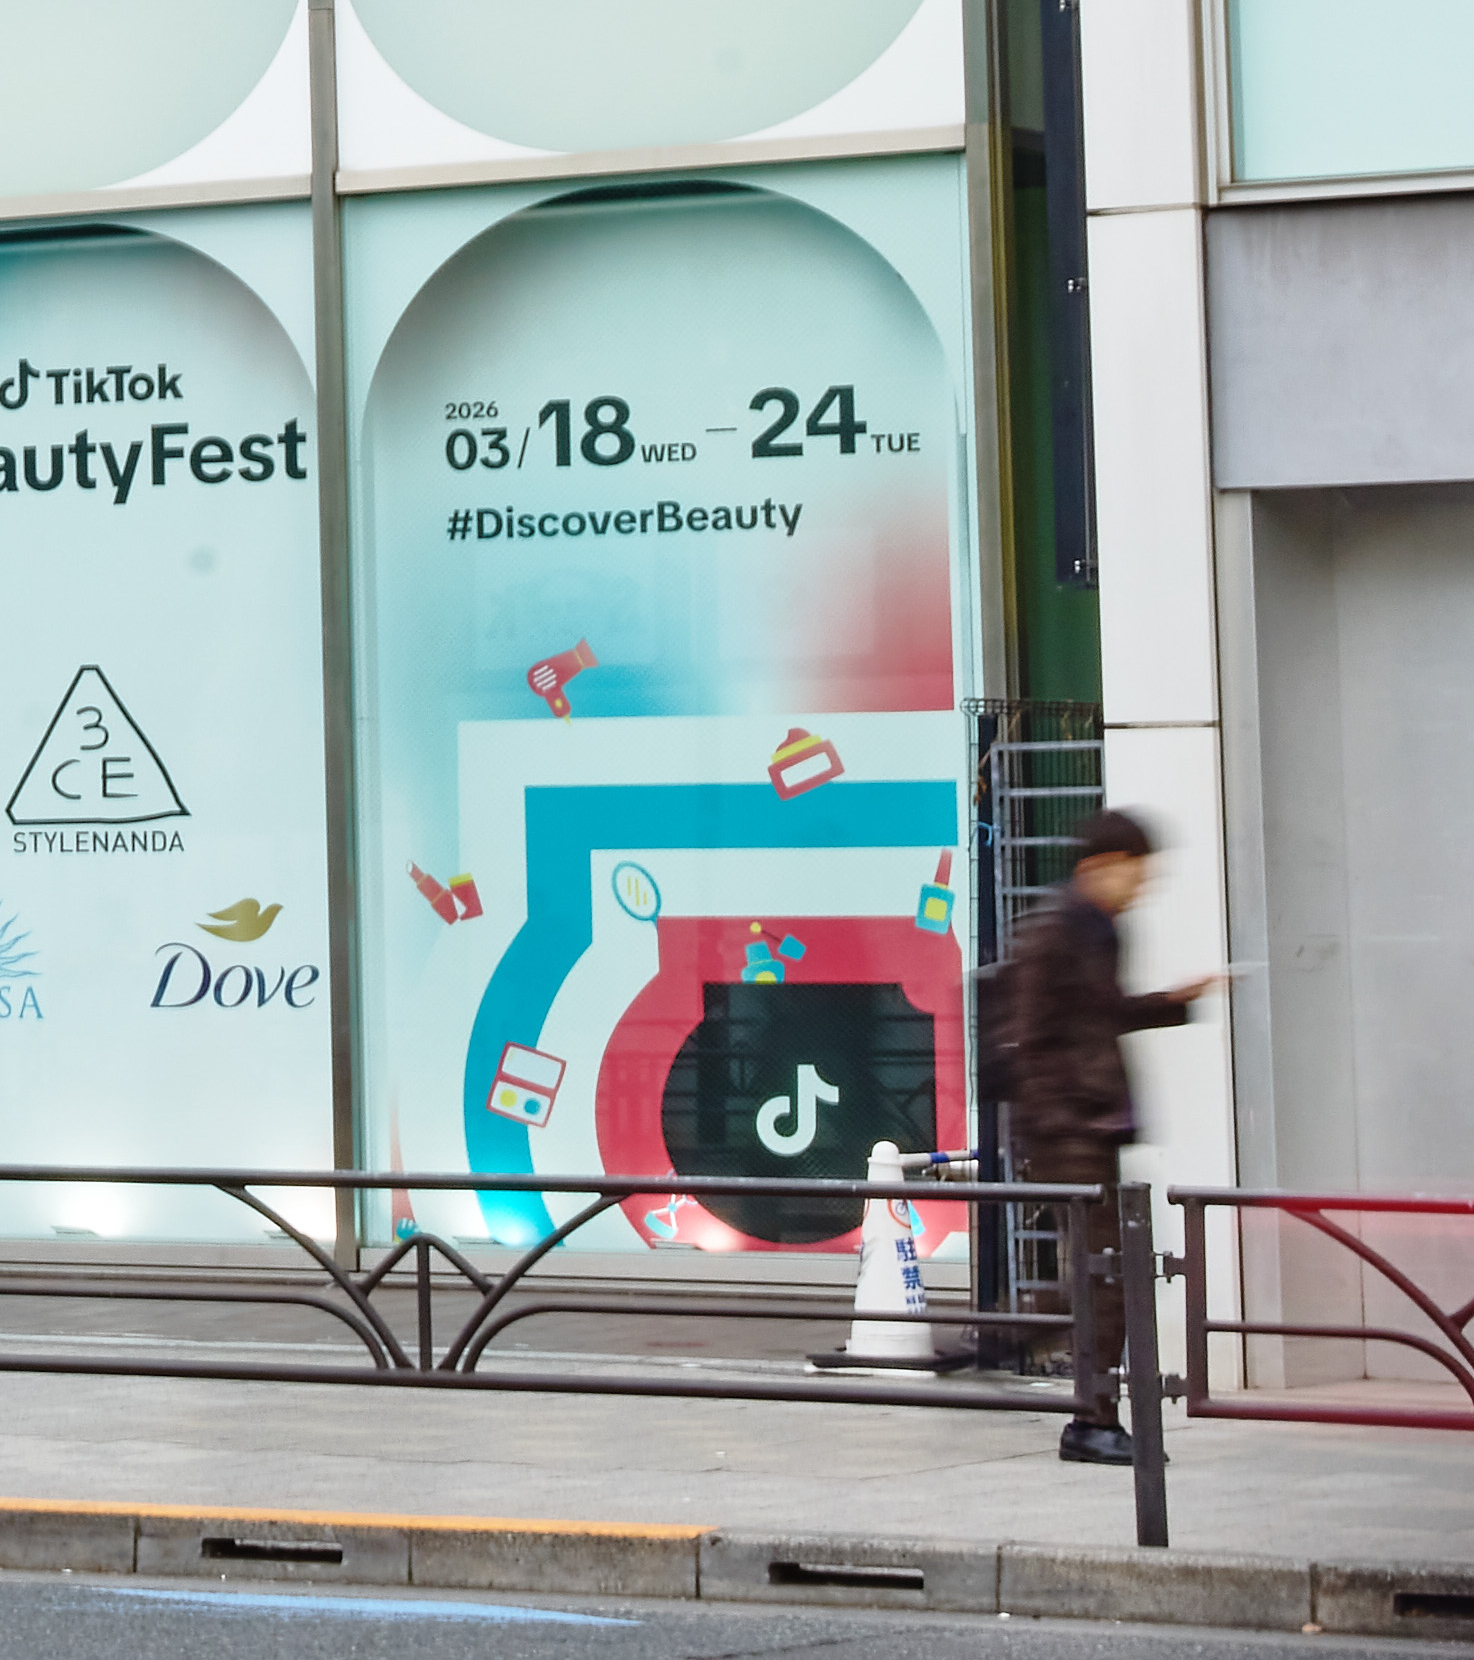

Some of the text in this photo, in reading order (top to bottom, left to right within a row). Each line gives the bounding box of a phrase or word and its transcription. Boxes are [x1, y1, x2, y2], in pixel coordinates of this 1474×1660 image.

[46, 363, 183, 407] TikTok
[444, 401, 499, 420] 2026
[641, 440, 698, 463] WED
[747, 385, 868, 459] 24
[871, 430, 922, 455] TUE
[446, 497, 804, 543] #DiscoverBeauty
[13, 830, 185, 855] STYLENANDA
[149, 942, 321, 1010] Dove
